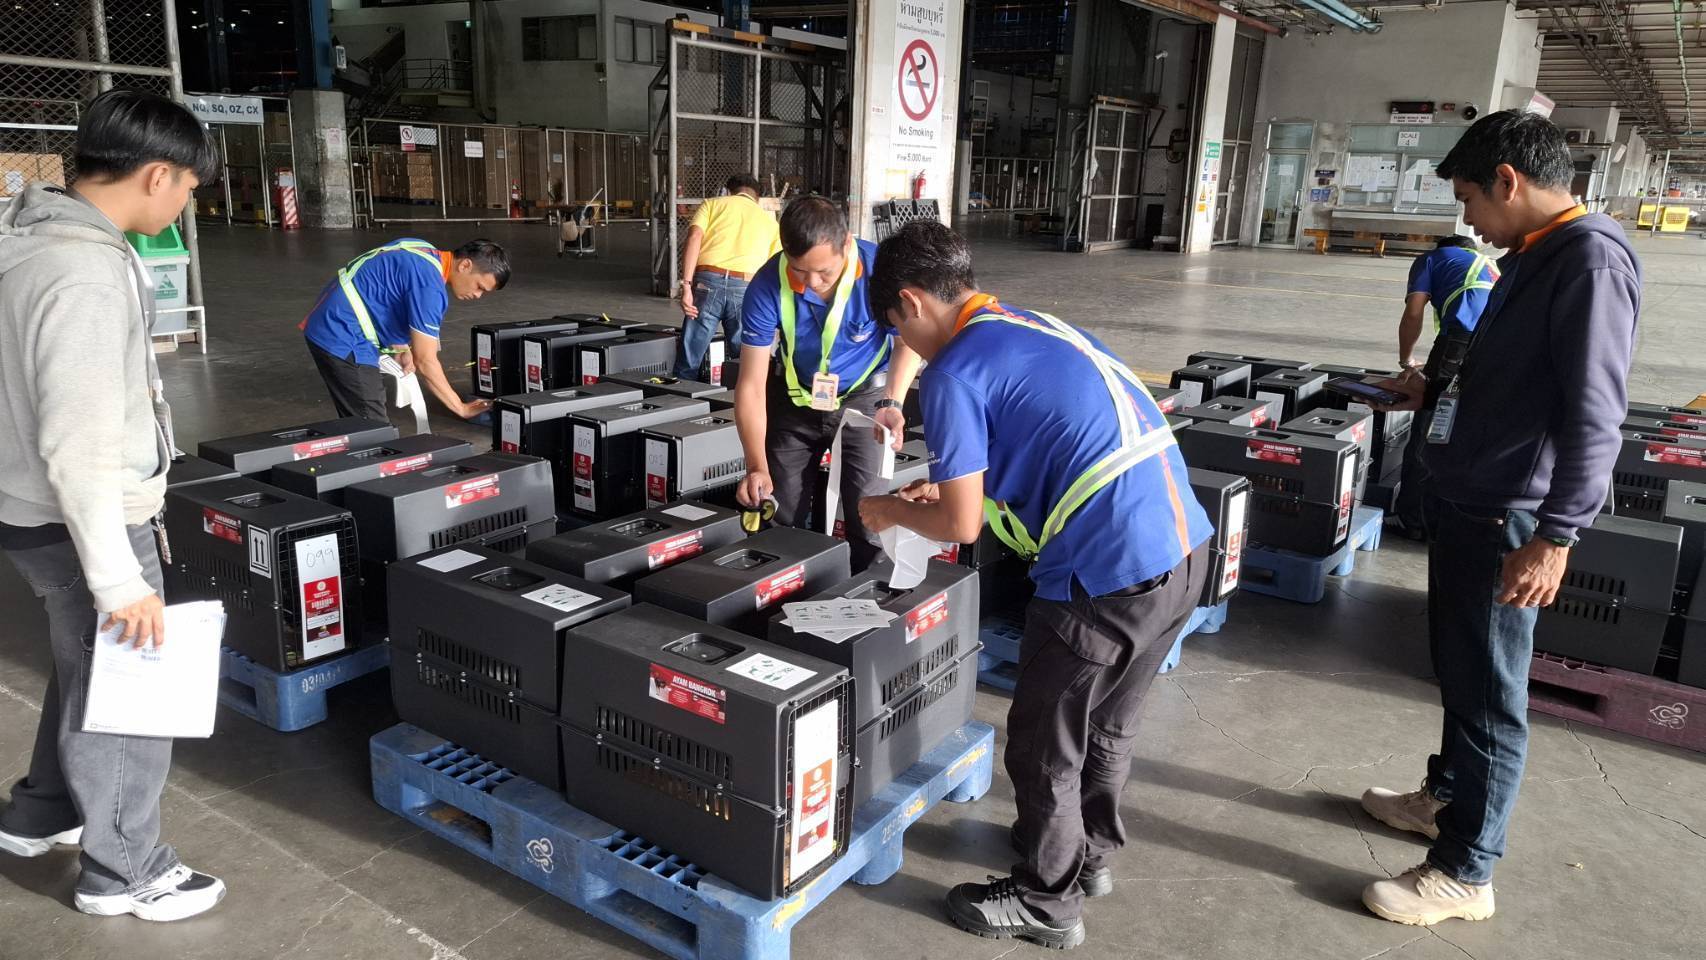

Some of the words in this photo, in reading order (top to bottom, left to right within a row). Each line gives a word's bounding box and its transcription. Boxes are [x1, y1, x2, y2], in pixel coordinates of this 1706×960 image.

[246, 106, 259, 114] CX
[898, 125, 907, 135] No
[908, 126, 934, 140] Smoking
[672, 675, 689, 687] AYAM
[688, 680, 717, 698] BANGKOK
